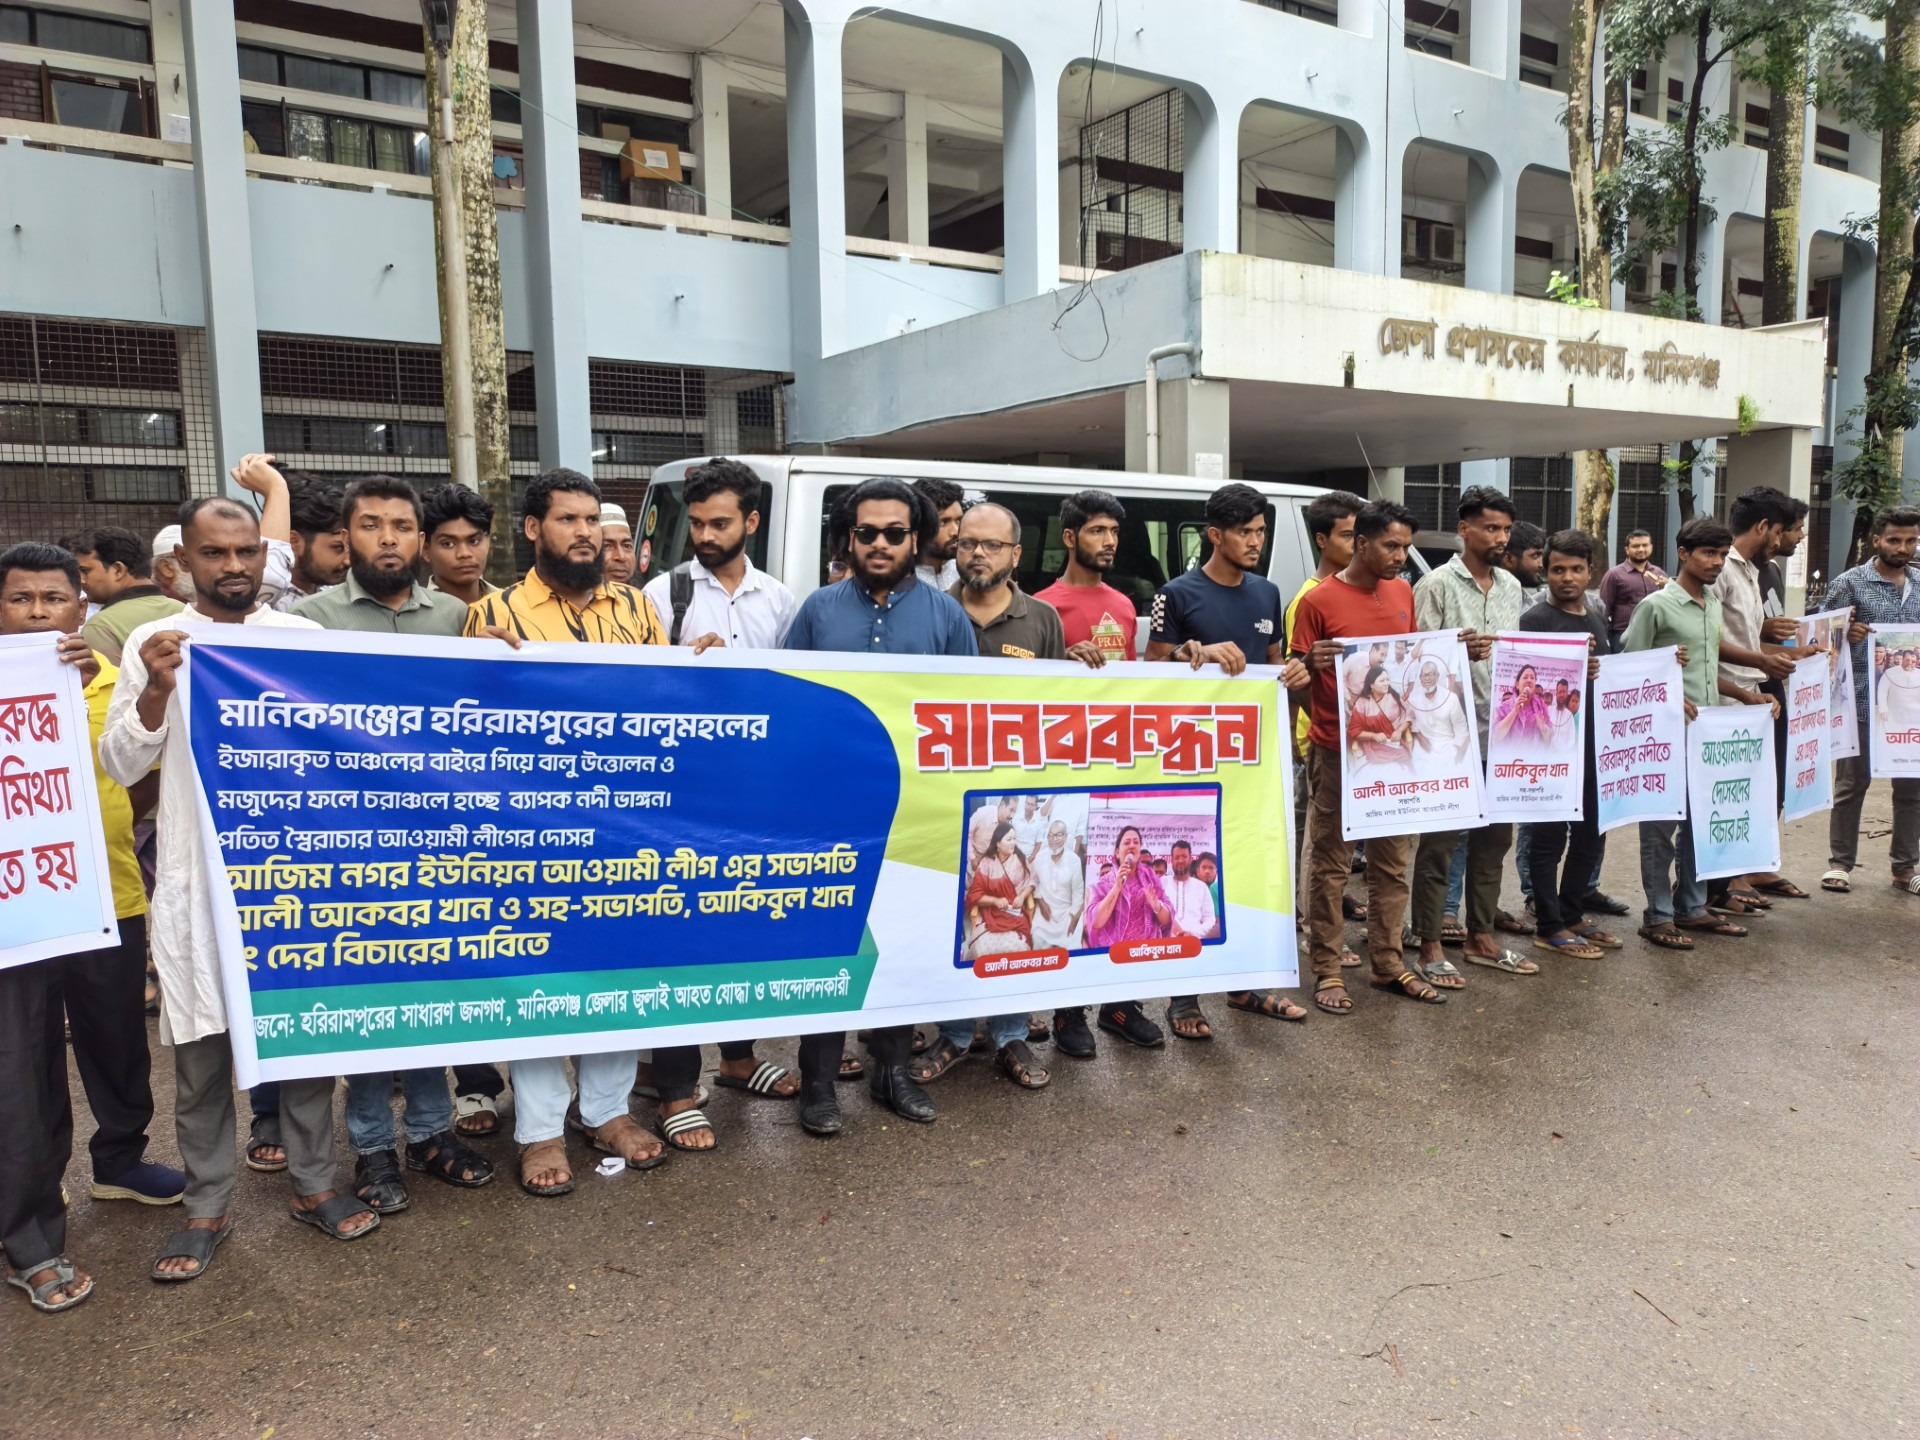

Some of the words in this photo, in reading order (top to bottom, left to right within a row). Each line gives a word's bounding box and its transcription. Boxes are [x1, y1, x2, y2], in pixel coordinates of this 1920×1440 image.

[1379, 317, 1439, 360] জেলা
[1446, 322, 1546, 373] প্রশাসকের
[1644, 340, 1721, 390] মানিকগঞ্জ
[218, 691, 424, 736] মানিকগঞ্জের
[430, 698, 616, 744] হরিরামপুরের
[622, 713, 769, 747] বালুমহলের
[1611, 719, 1628, 739] কথা
[1630, 714, 1653, 735] বললে
[912, 701, 1262, 774] মানববন্ধন
[1638, 736, 1671, 763] নদীতে
[1702, 729, 1764, 766] আওয়ামীলীগের
[217, 743, 330, 777] ইজারাকৃত
[335, 752, 424, 773] অঞ্চলের
[430, 748, 486, 773] বাইরে
[491, 747, 534, 773] গিয়ে
[538, 755, 577, 778] বালু
[581, 750, 656, 773] উত্তোলন
[660, 757, 675, 773] ও
[1494, 759, 1548, 784] আকিবুল
[1550, 763, 1569, 777] খান
[0, 755, 72, 820] মিথ্যা
[1353, 781, 1386, 799] আলী
[1388, 780, 1440, 795] আকবর
[1443, 777, 1469, 790] খান
[1642, 773, 1666, 793] যায়
[1712, 778, 1751, 804] দোসরদের
[217, 791, 302, 816] মজুদের
[307, 791, 358, 809] ফলে
[363, 792, 448, 810] চরাঞ্চলে
[453, 792, 501, 811] হচ্ছে
[509, 792, 572, 810] ব্যাপক
[576, 785, 609, 808] নদী
[218, 825, 281, 850] পতিত
[284, 826, 373, 852] স্বৈরাচার
[378, 824, 469, 849] আওয়ামী
[473, 824, 536, 848] লীগের
[539, 828, 596, 847] দোসর
[1709, 811, 1734, 844] বিচার
[1735, 810, 1750, 843] চাই
[31, 841, 78, 892] হয়
[226, 855, 333, 890] আজিম
[340, 862, 411, 889] নগর
[416, 852, 537, 887] ইউনিয়ন
[542, 849, 661, 885] আওয়ামী
[665, 848, 718, 879] লীগ
[723, 855, 763, 879] এর
[767, 843, 858, 875] সভাপতি
[309, 900, 432, 927] আকবর
[438, 898, 493, 922] খান
[499, 897, 521, 920] ও
[529, 884, 691, 922] সহ-সভাপতি,
[698, 882, 807, 919] আকিবুল
[812, 885, 855, 908] খান
[267, 943, 327, 970] দের
[333, 932, 451, 966] বিচারের
[458, 925, 551, 960] দাবিতে
[985, 959, 1008, 972] আলী
[1009, 960, 1042, 971] আকবর
[1044, 955, 1059, 966] খান
[1129, 944, 1166, 959] আকিবুল
[1167, 944, 1181, 954] খান
[299, 1002, 397, 1037] হরিরামপুরের
[400, 1000, 455, 1028] সাধারণ
[517, 989, 580, 1020] মানিকগঞ্জ
[586, 989, 629, 1016] জেলার
[631, 980, 671, 1017] জুলাই
[673, 983, 713, 1009] আহত
[715, 980, 750, 1005] যোদ্ধা
[754, 982, 764, 1000] ও
[769, 967, 851, 1003] আন্দোলনকারী
